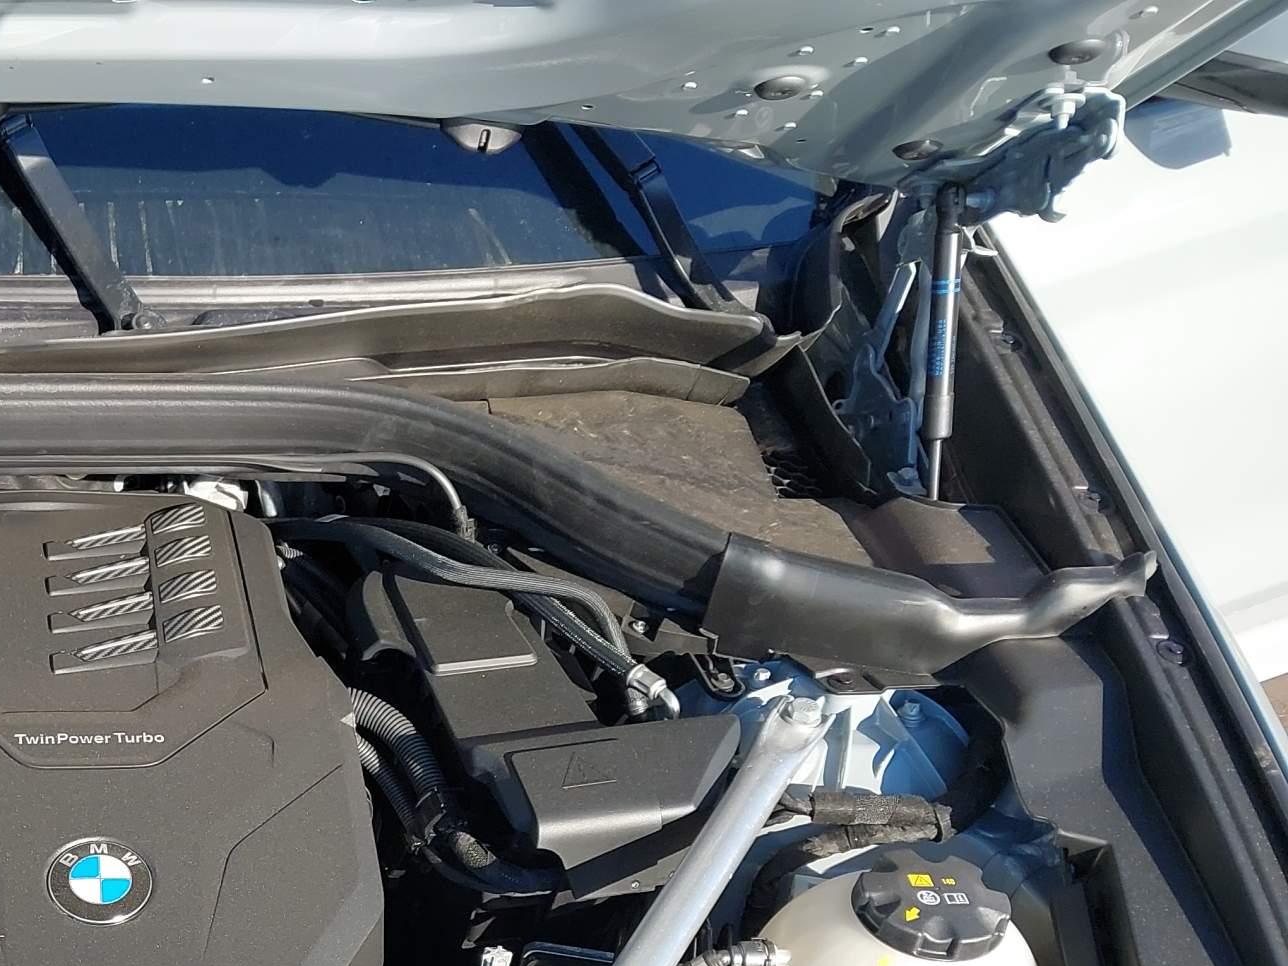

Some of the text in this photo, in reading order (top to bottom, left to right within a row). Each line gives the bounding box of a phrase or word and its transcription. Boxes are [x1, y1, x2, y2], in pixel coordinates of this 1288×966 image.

[14, 732, 165, 745] TwinPower Turbo
[59, 843, 141, 867] BMW
